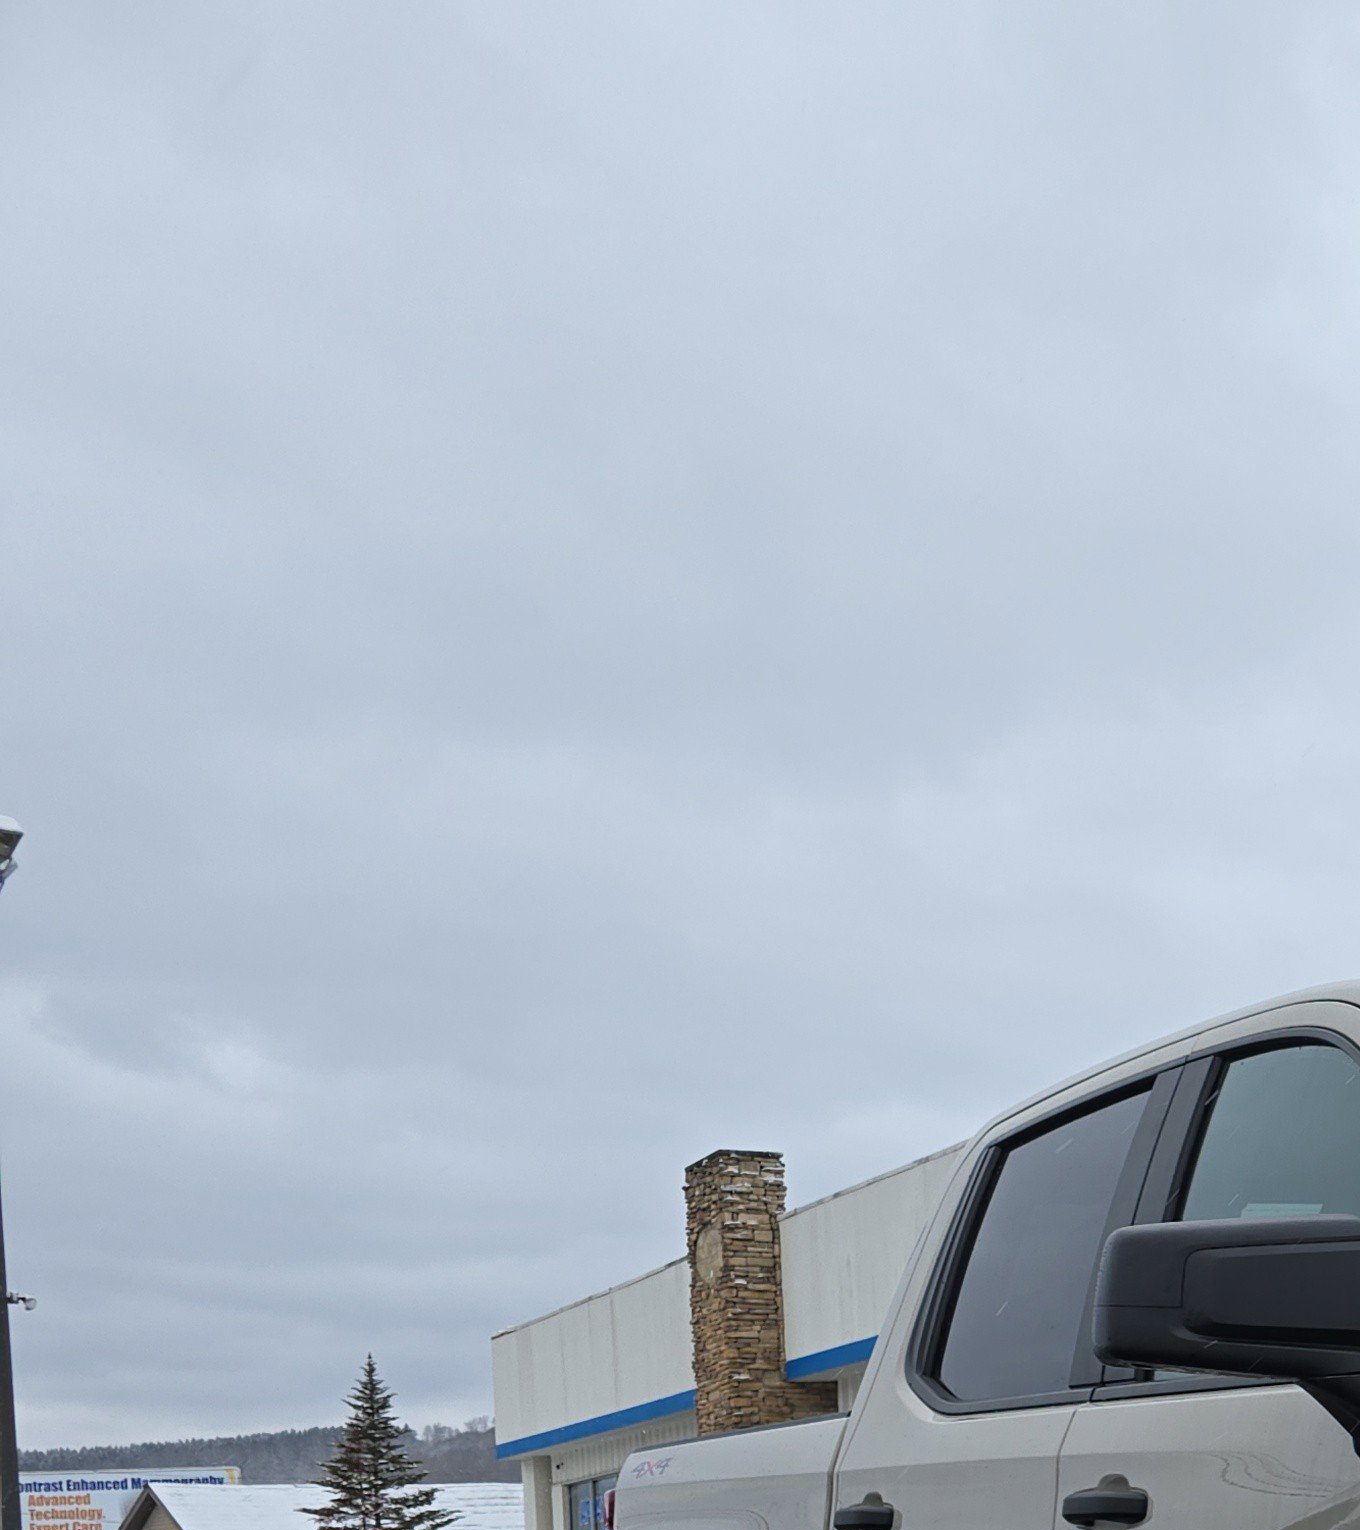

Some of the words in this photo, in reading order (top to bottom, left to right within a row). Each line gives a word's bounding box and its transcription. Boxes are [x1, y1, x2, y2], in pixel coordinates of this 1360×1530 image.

[19, 1480, 63, 1493] ontrast
[66, 1478, 128, 1492] Enhanced
[28, 1494, 91, 1507] Advanced
